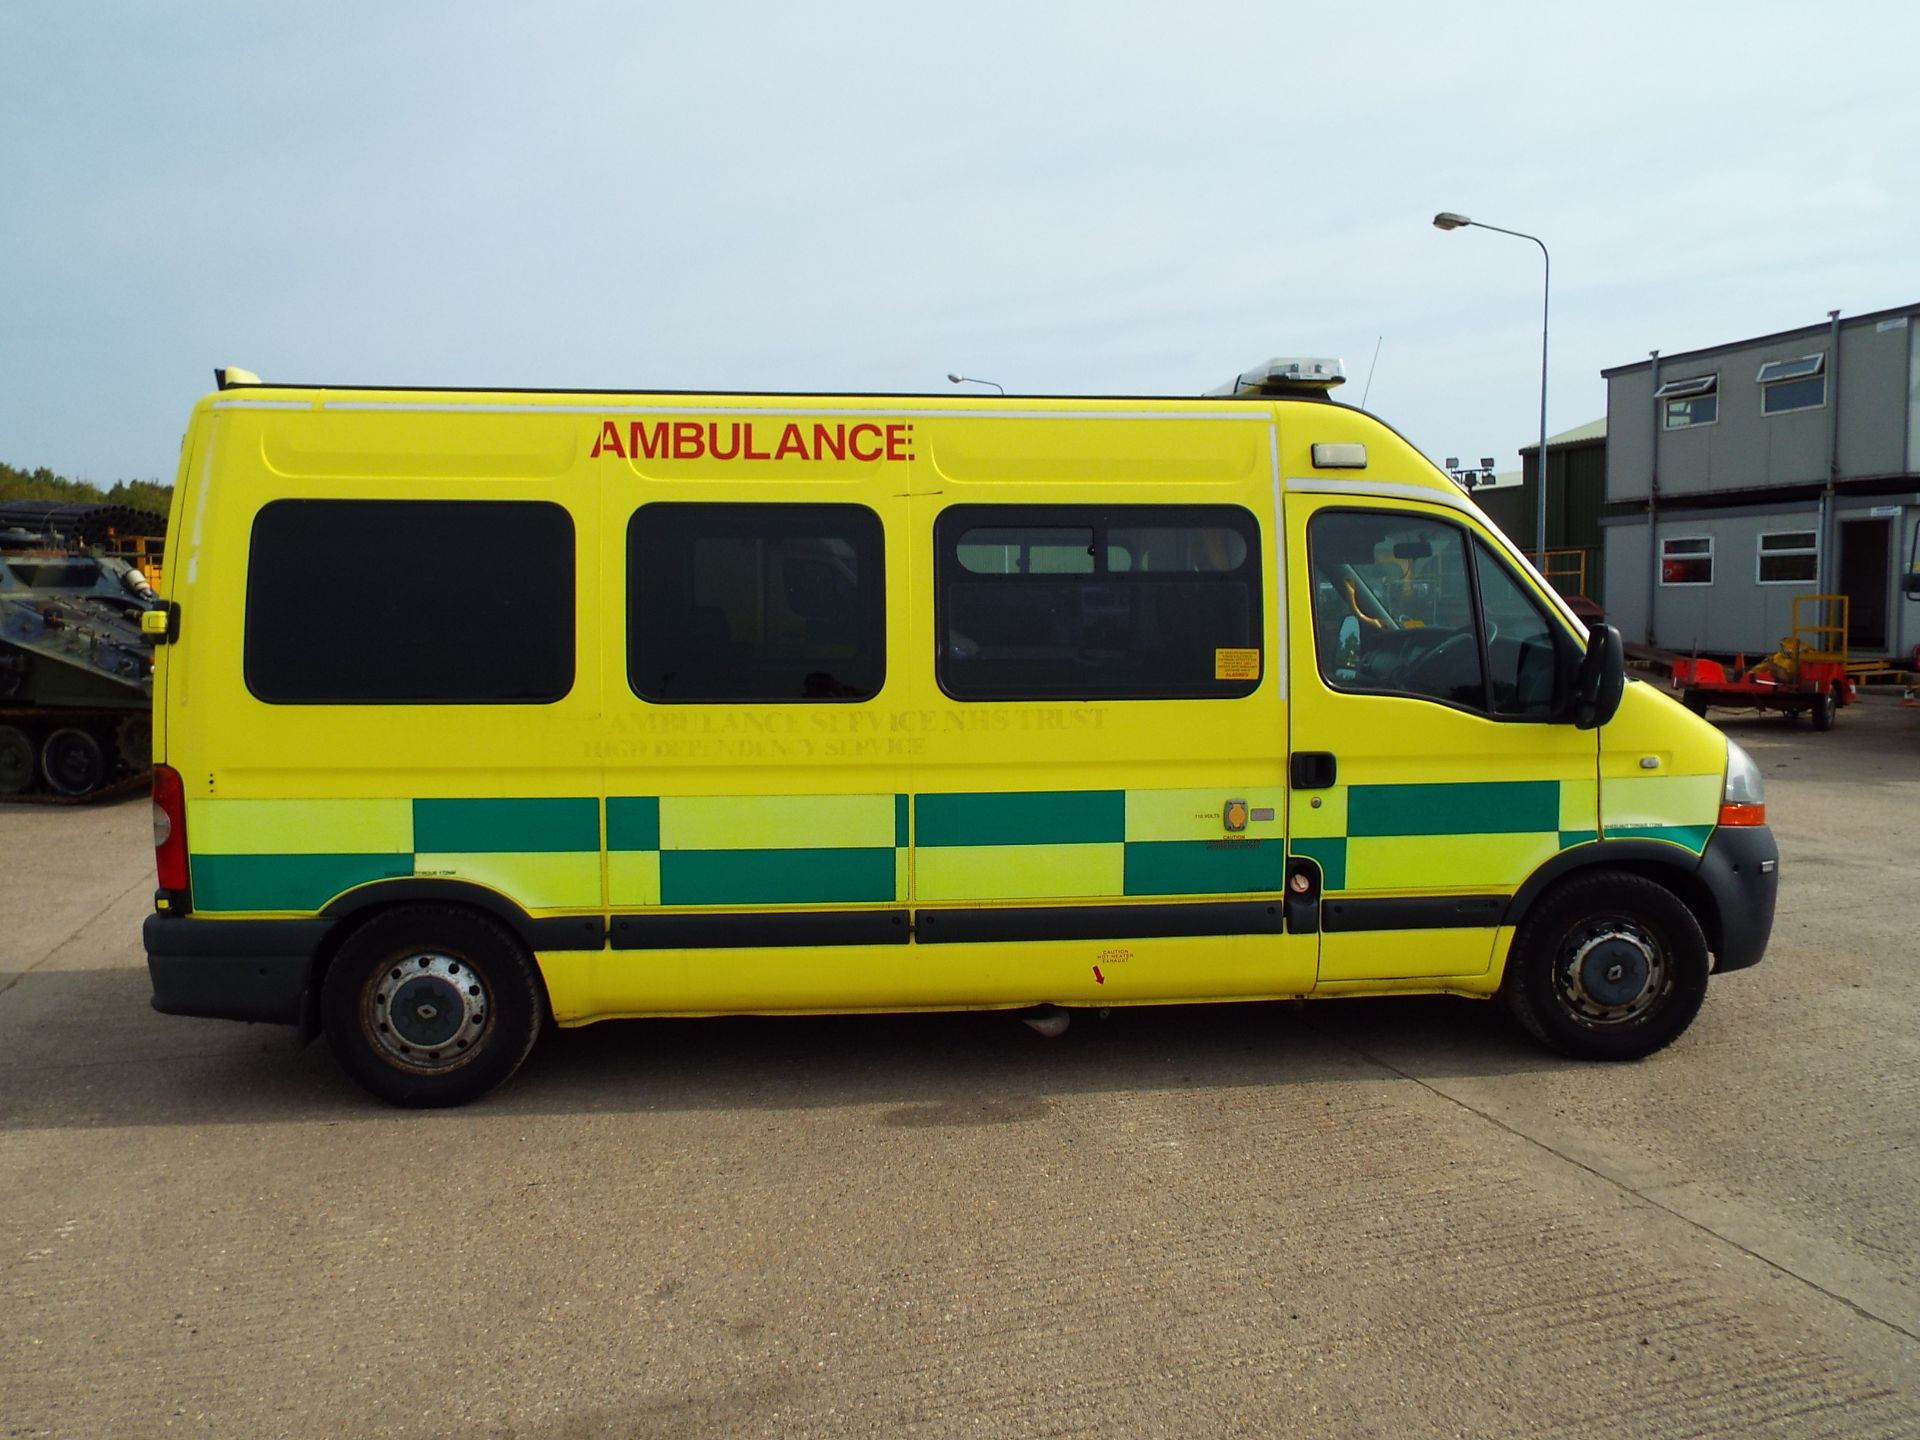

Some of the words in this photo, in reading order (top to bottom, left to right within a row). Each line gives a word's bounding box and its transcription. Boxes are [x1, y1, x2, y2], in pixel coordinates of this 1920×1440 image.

[590, 421, 915, 461] AMBULANCE
[943, 709, 1009, 732] NHS
[1014, 707, 1110, 730] TRUST
